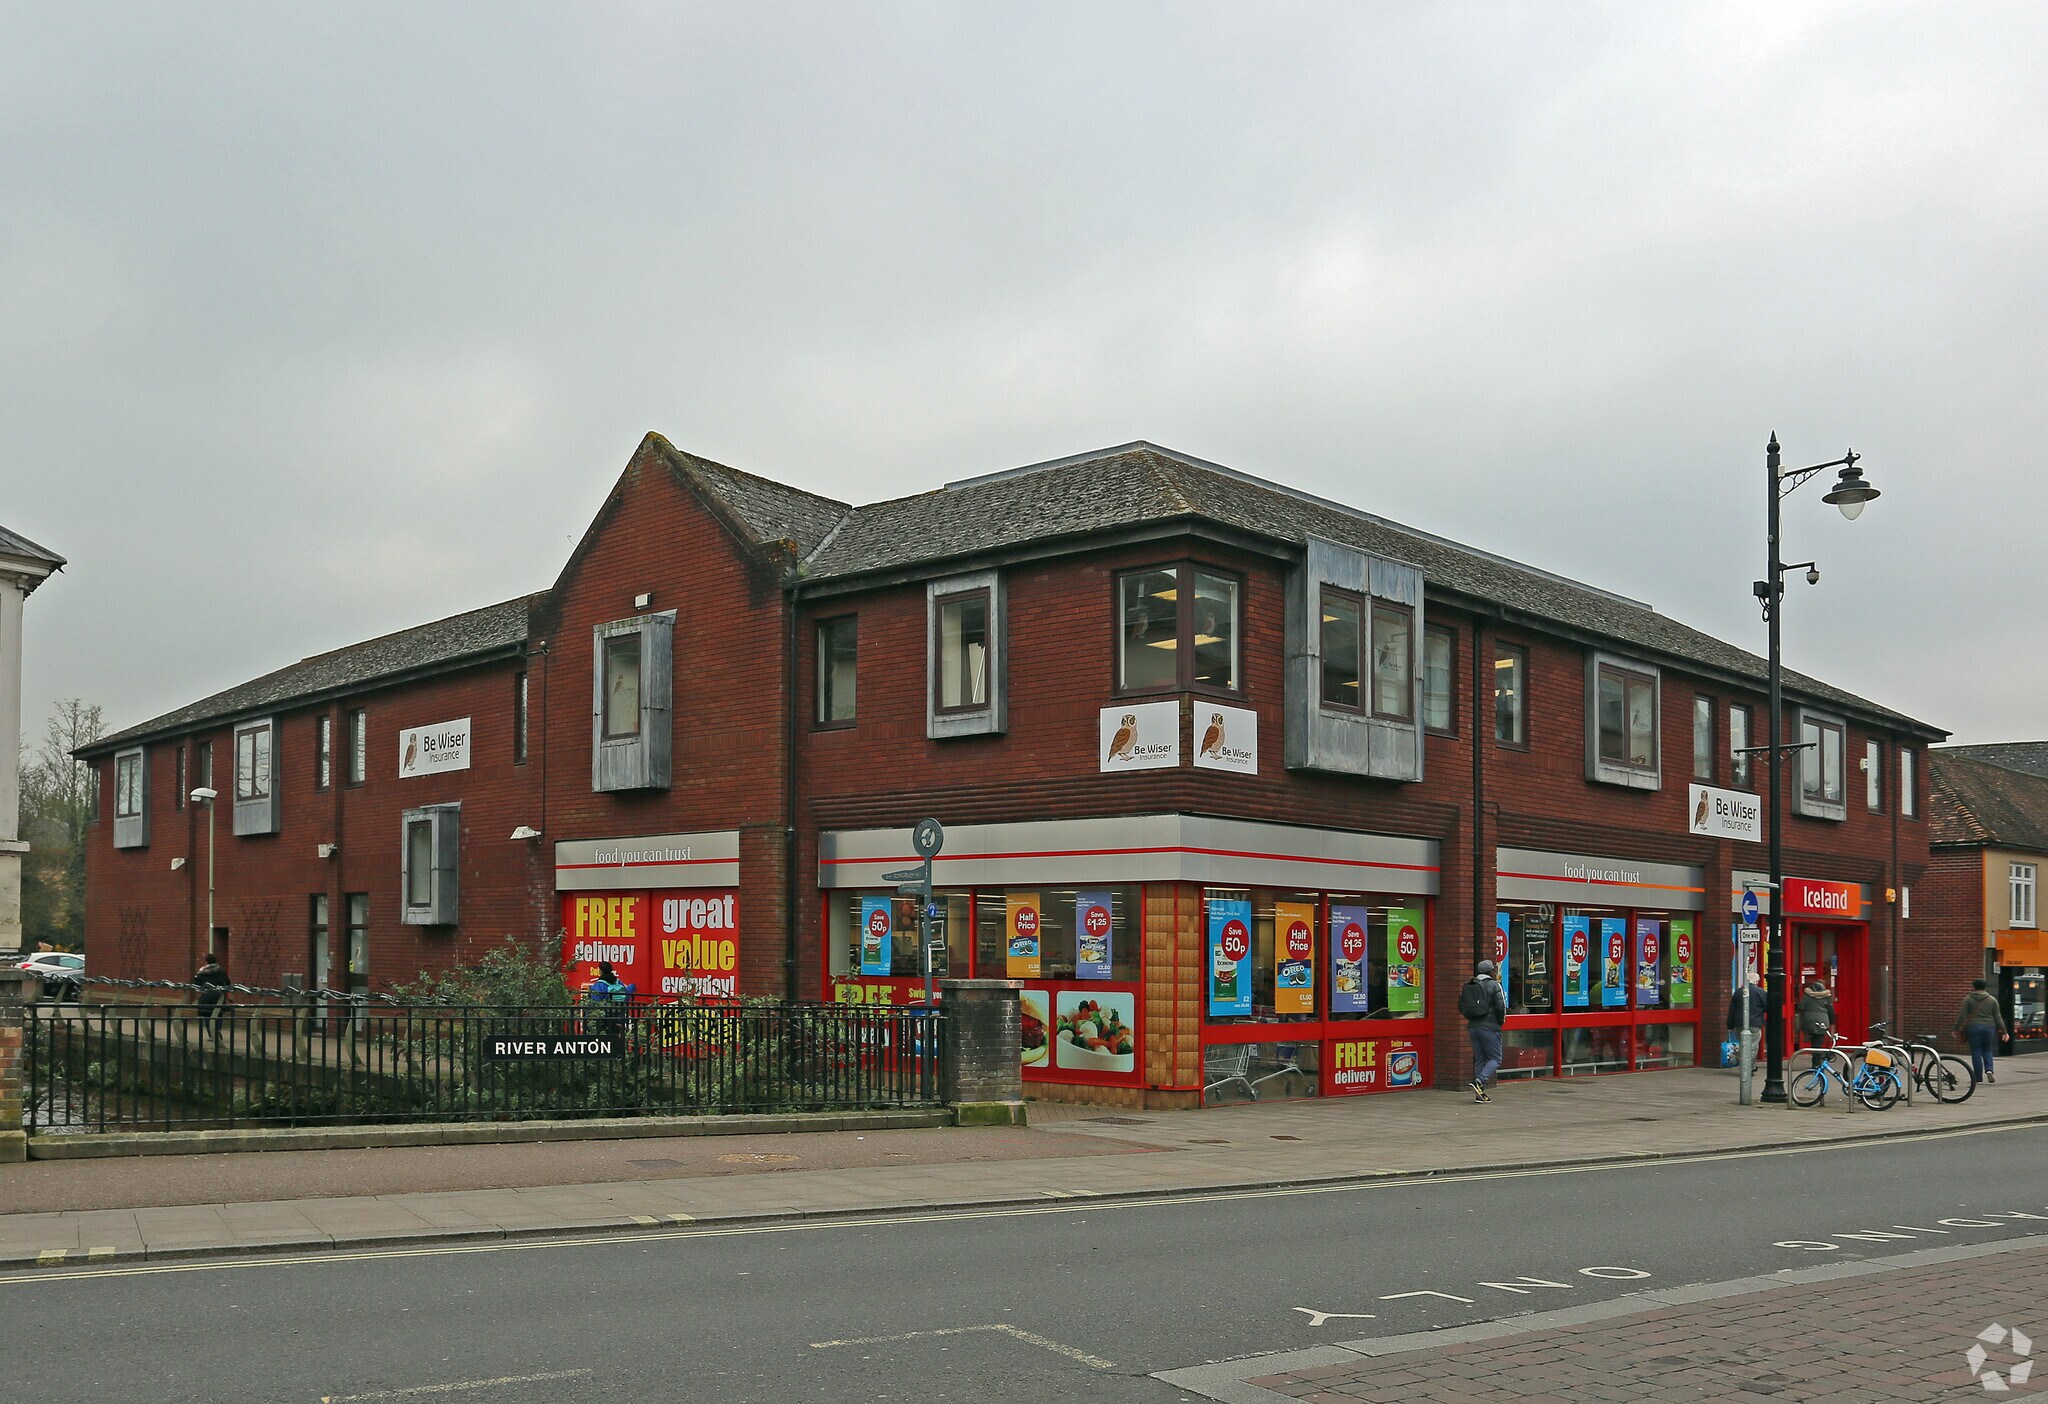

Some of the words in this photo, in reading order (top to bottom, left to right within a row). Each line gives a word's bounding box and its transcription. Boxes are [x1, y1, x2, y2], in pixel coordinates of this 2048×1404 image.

[424, 736, 436, 752] Be
[438, 732, 465, 750] Wiser
[1134, 745, 1145, 754] Be
[1148, 744, 1172, 754] Wiser
[1222, 746, 1232, 757] Be
[1232, 748, 1252, 760] Wiser
[429, 750, 460, 763] Insurance
[1140, 752, 1167, 760] Insurance
[1226, 756, 1248, 765] Insurance
[1716, 798, 1728, 816] Be
[1730, 800, 1756, 820] Wiser
[1722, 817, 1752, 832] Insurance
[594, 848, 618, 864] food
[621, 850, 640, 867] you
[643, 850, 662, 862] can
[665, 846, 692, 861] trust
[1564, 862, 1585, 879] food
[1586, 867, 1602, 884] you
[1604, 870, 1619, 882] can
[1620, 870, 1640, 884] trust
[1803, 886, 1848, 910] Iceland
[662, 894, 735, 934] great
[1019, 913, 1034, 921] Half
[871, 920, 887, 932] 50p
[1018, 922, 1036, 930] Price
[1087, 918, 1106, 930] £1.25
[1228, 927, 1242, 935] Save
[1292, 930, 1307, 940] Half
[1347, 930, 1359, 938] Save
[1402, 932, 1414, 940] Save
[661, 934, 735, 970] value
[1226, 938, 1246, 954] 50p
[1290, 940, 1308, 951] Price
[1344, 939, 1362, 954] £1.25
[1400, 942, 1416, 956] 50p
[1573, 945, 1585, 957] 50p
[1612, 946, 1621, 958] £1
[575, 941, 636, 965] delivery
[1679, 947, 1689, 958] 50p
[1282, 965, 1304, 976] OREO
[662, 975, 735, 998] everyday!
[908, 987, 926, 998] Swip
[495, 1042, 547, 1055] RIVER
[554, 1041, 611, 1055] ANTON
[1335, 1070, 1375, 1085] delivery
[1293, 1266, 1651, 1327] ONLY
